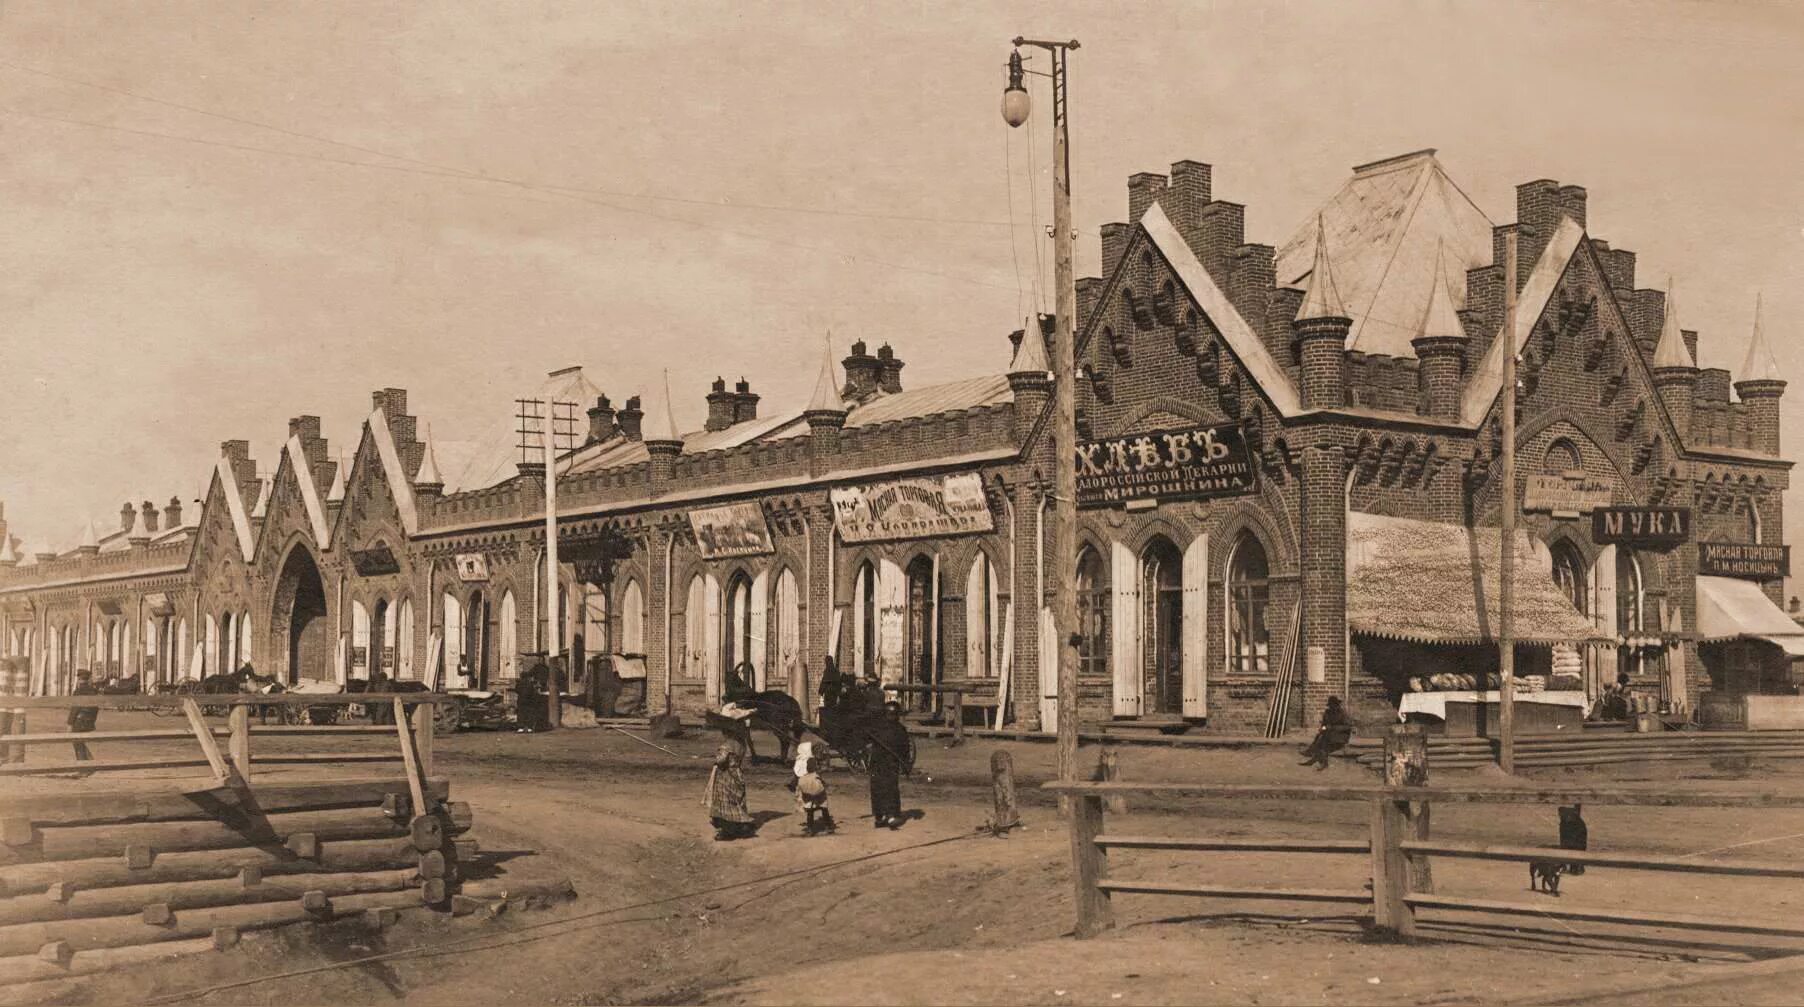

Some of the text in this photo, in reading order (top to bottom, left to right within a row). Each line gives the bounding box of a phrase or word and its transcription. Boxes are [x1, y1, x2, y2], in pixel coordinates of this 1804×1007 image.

[1183, 462, 1248, 482] ПЕКАРНИ
[1604, 511, 1682, 535] МУКА
[1705, 543, 1741, 562] МЯСНАЯ
